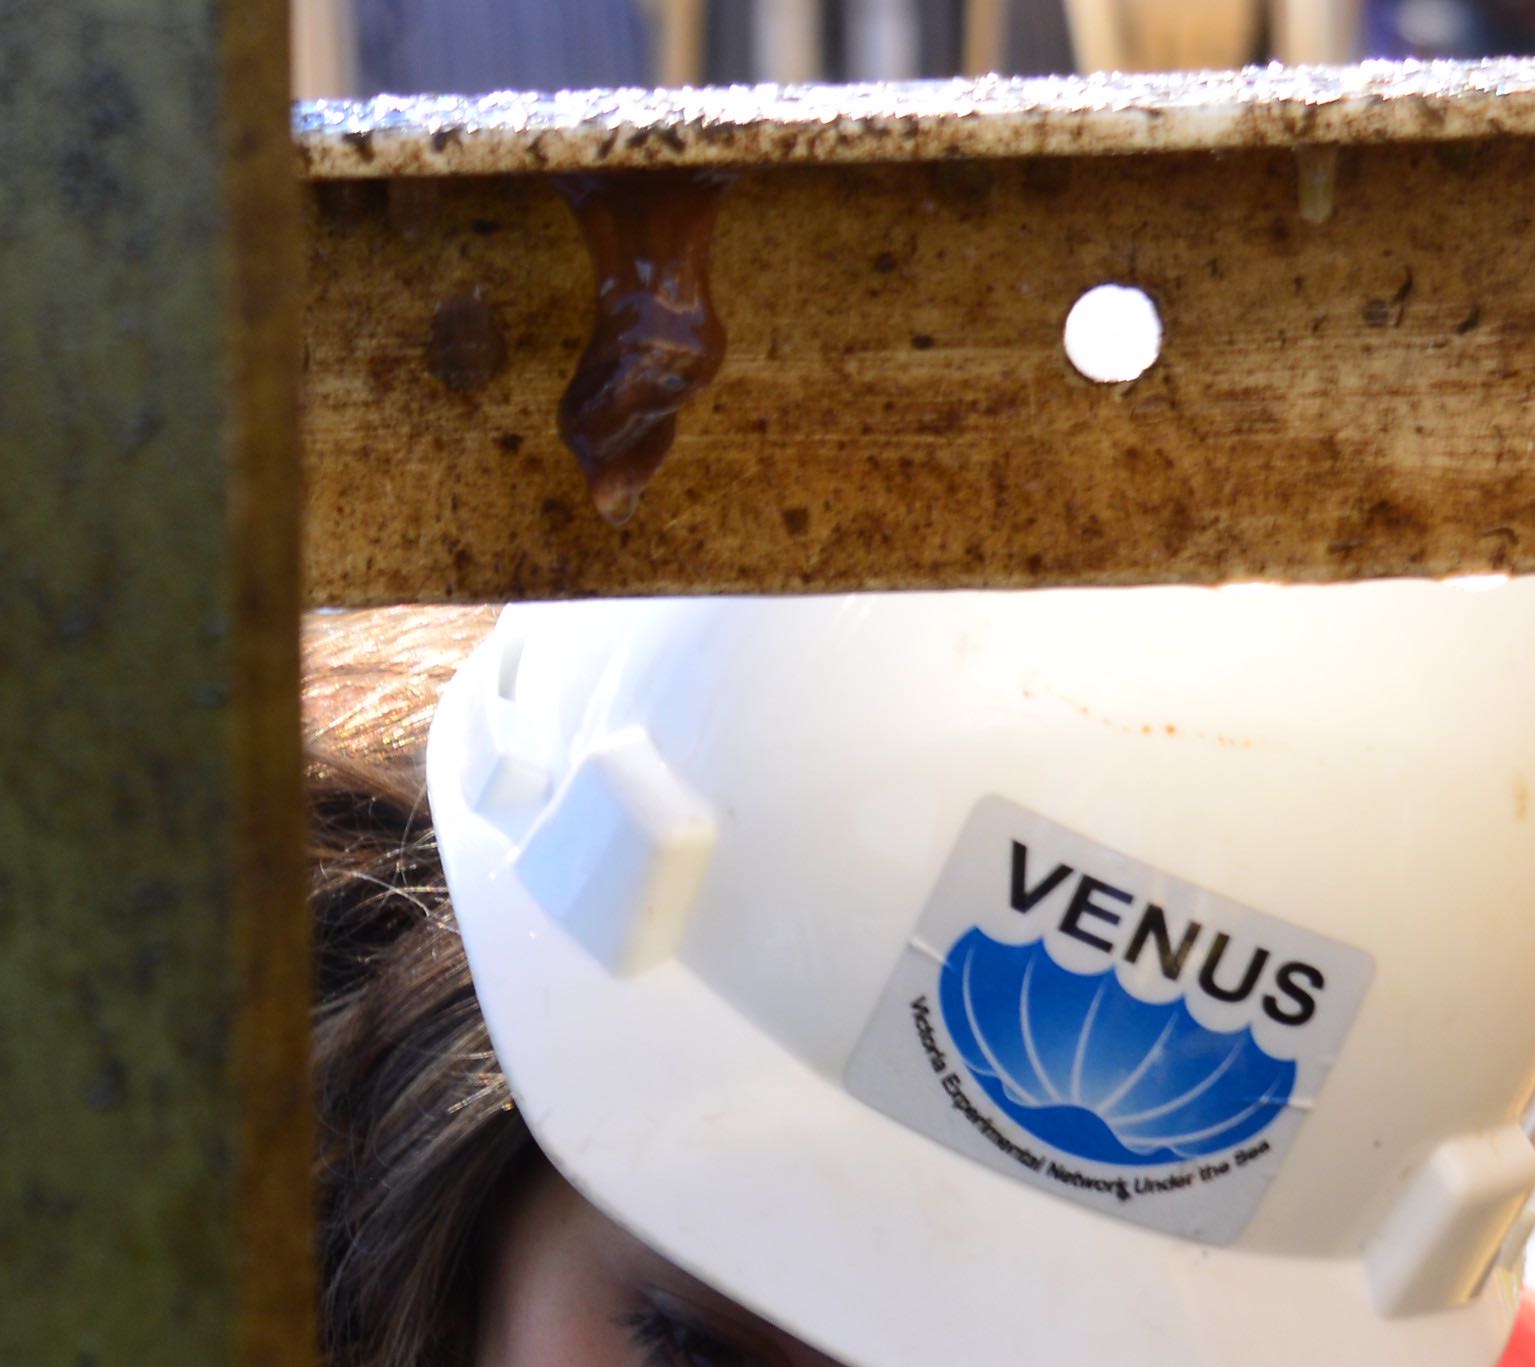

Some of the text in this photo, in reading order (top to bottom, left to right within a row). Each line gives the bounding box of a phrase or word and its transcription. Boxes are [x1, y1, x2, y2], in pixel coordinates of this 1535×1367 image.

[1008, 840, 1325, 1026] VENUS
[911, 996, 1270, 1200] Victoria Experimental Network Under the Sea
